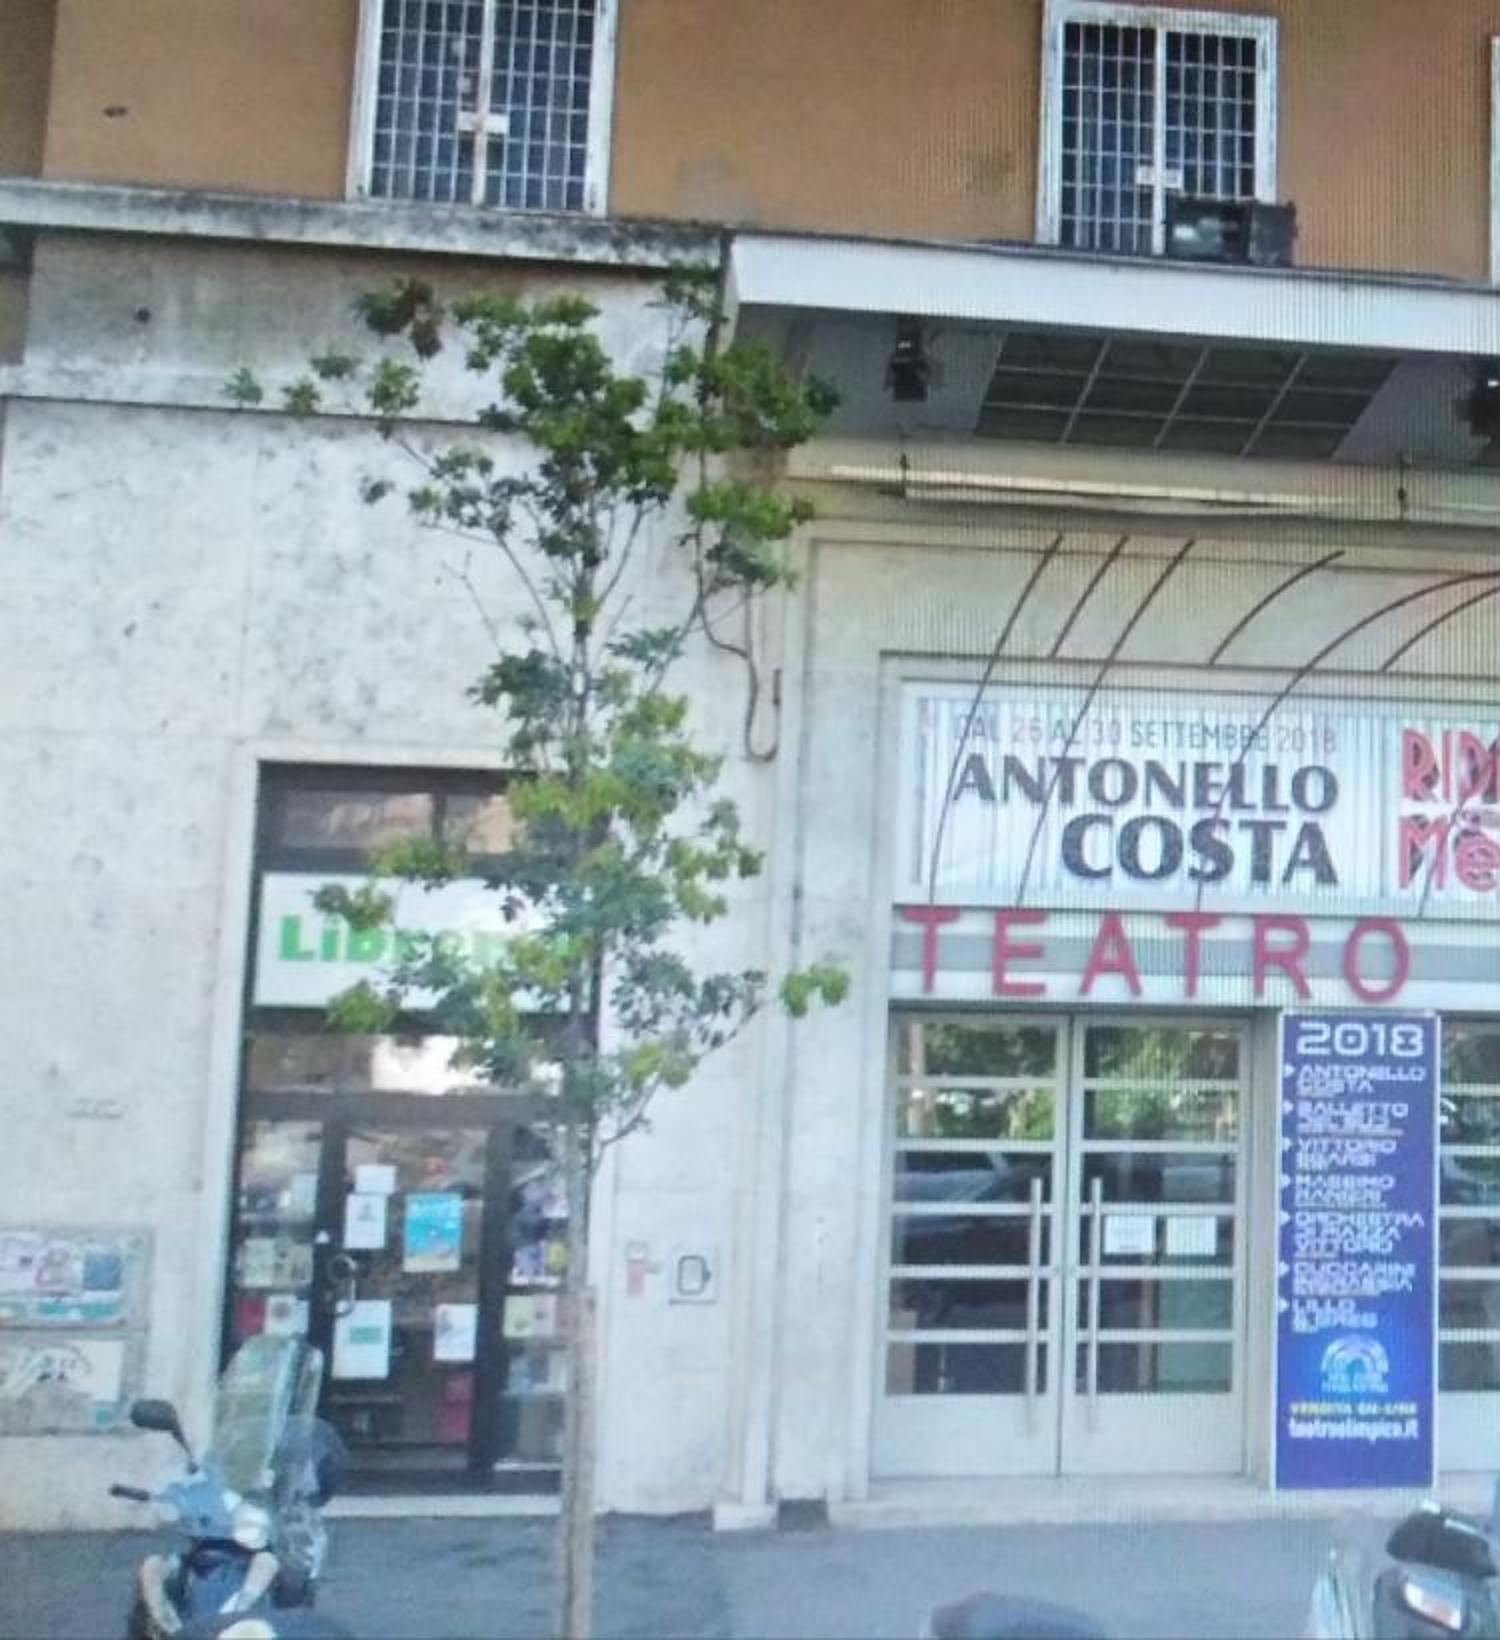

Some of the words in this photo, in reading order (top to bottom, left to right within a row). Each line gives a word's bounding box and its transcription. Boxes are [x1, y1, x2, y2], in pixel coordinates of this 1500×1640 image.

[951, 753, 1340, 814] ANTONELLO
[1060, 812, 1340, 887] COSTA
[901, 904, 1411, 1004] TEATRO
[1296, 1022, 1424, 1057] 2018
[1298, 1064, 1427, 1082] ANTONELLO
